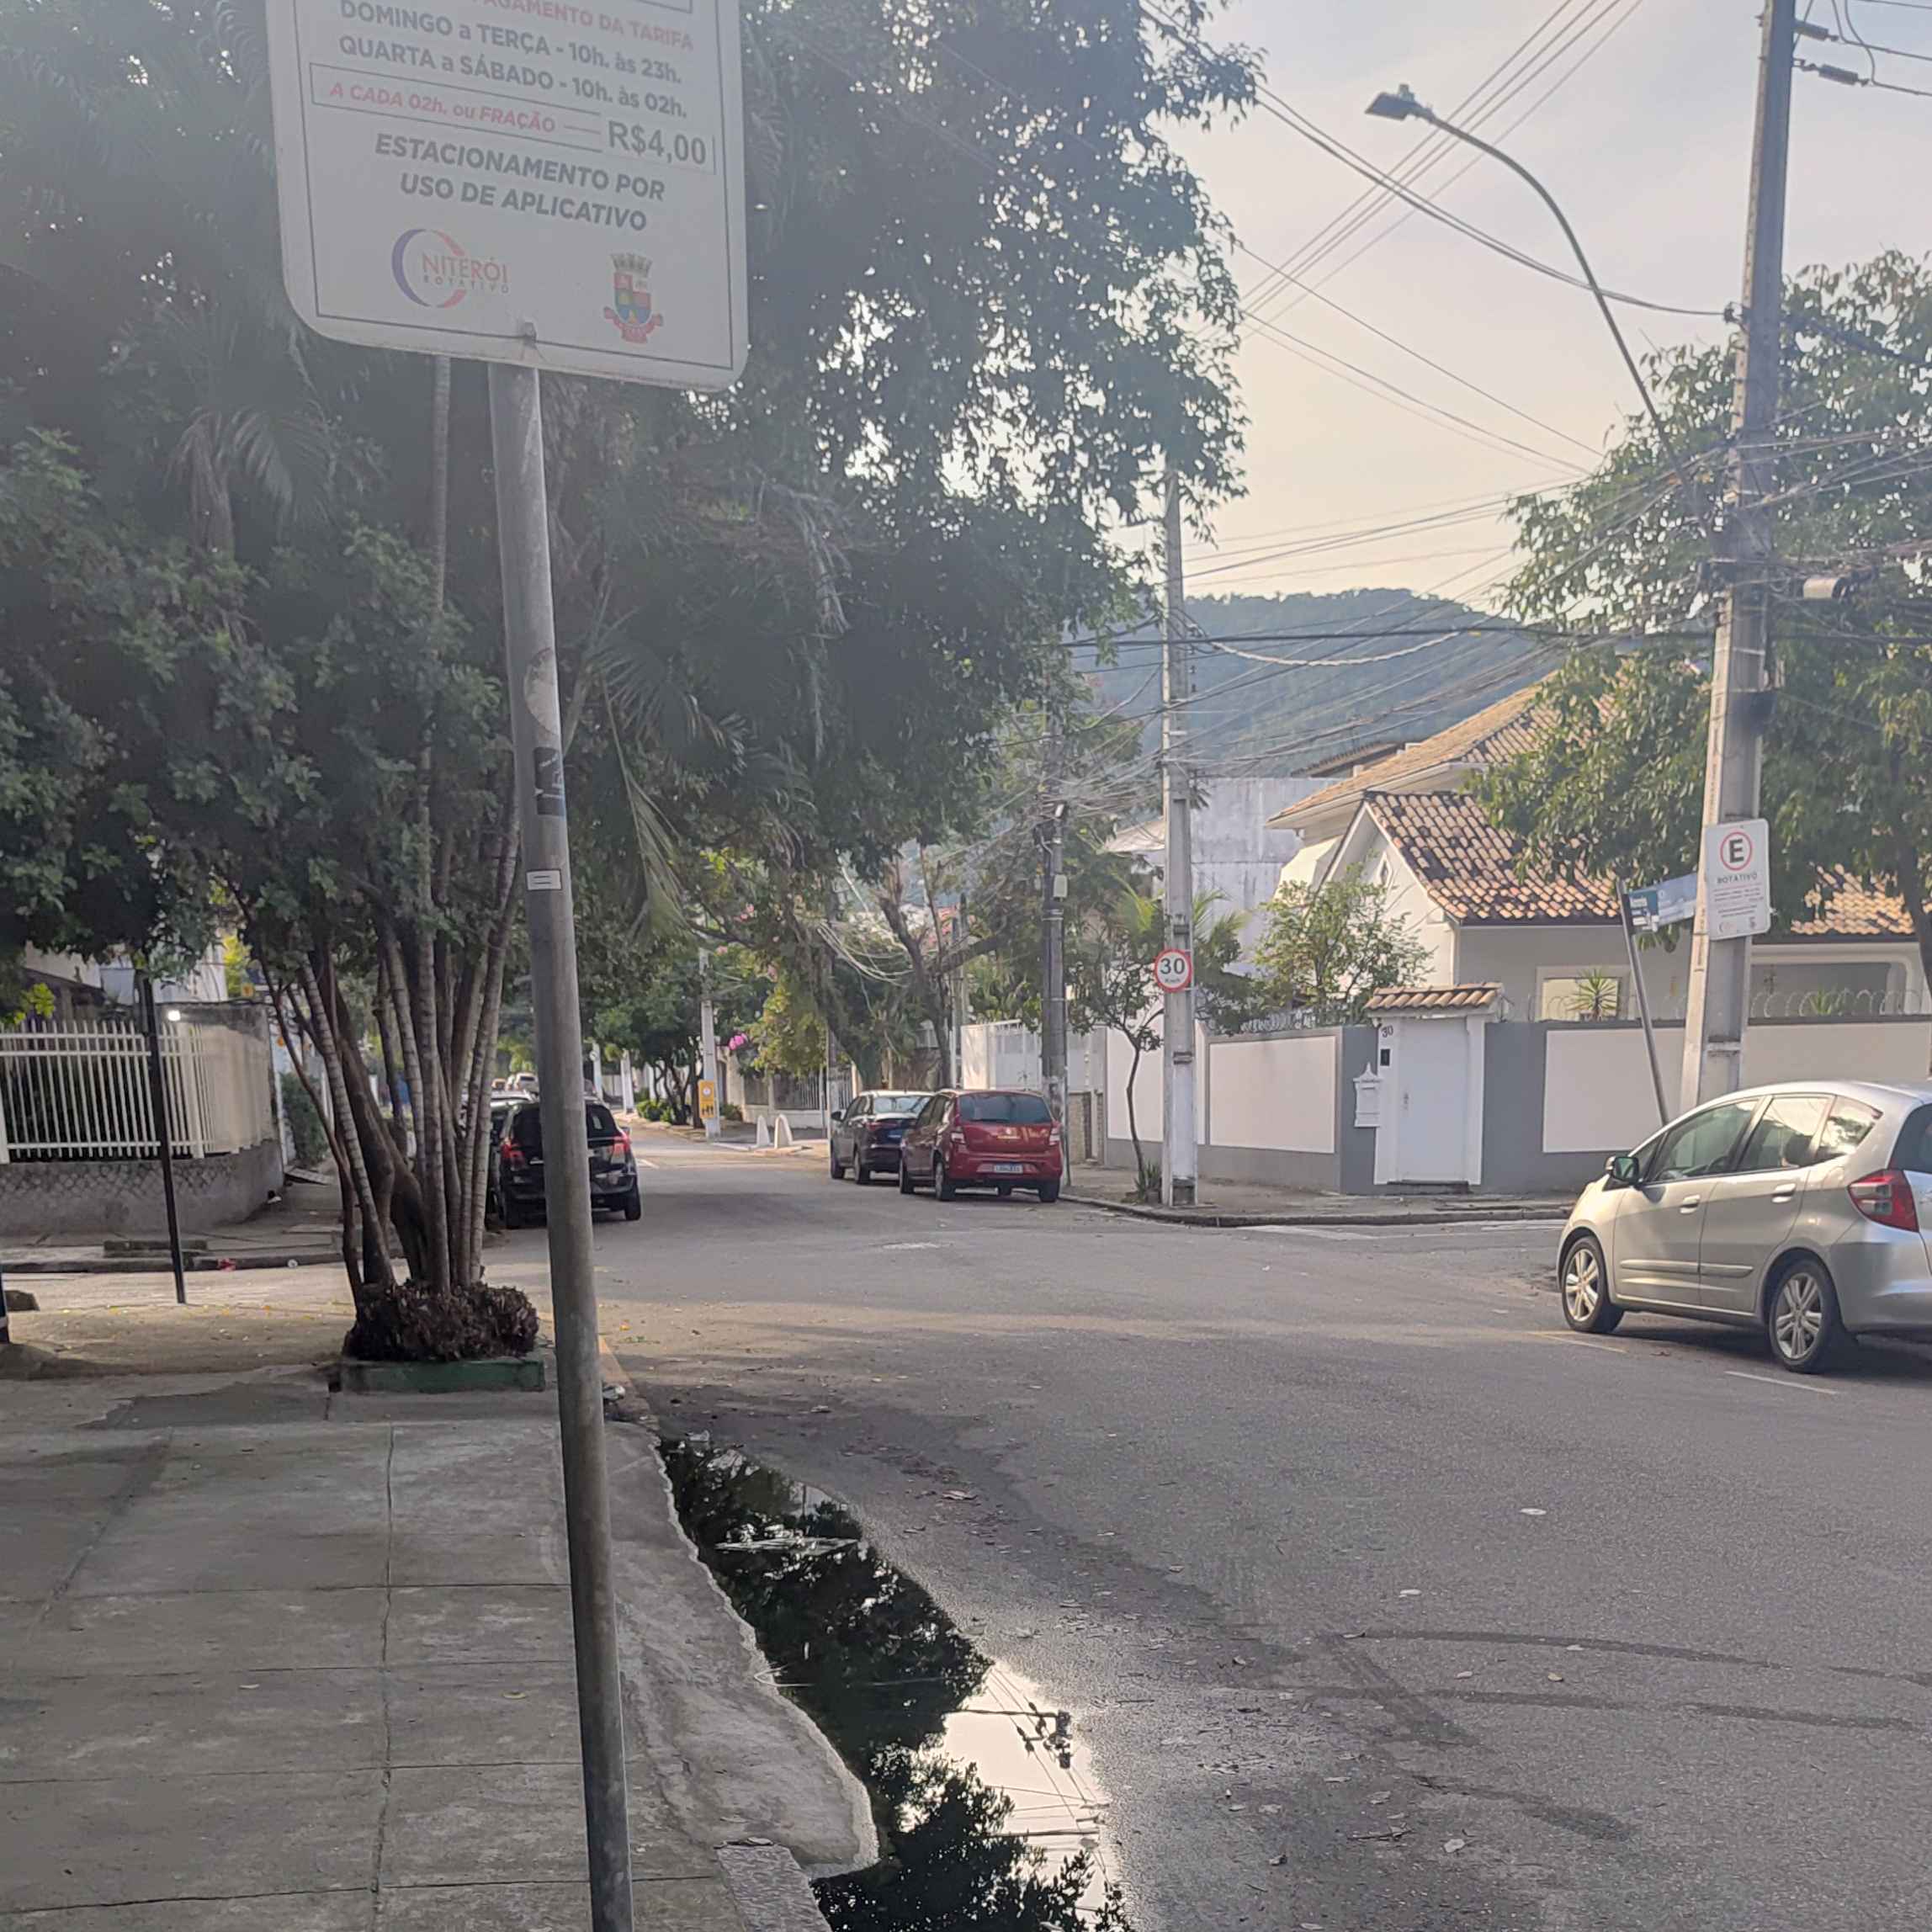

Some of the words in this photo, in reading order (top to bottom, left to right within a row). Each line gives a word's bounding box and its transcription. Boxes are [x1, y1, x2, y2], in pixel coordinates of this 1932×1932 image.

[340, 0, 453, 36] DOMINGO
[476, 24, 550, 56] TERÇA
[569, 42, 609, 68] 10h.
[614, 51, 637, 74] às
[641, 58, 682, 83] 23h.
[598, 13, 624, 35] DA
[627, 20, 694, 52] TARIFA
[339, 35, 437, 69] QUARTA
[459, 53, 554, 90] SÁBADO
[572, 77, 613, 103] 10h.
[618, 86, 640, 109] às
[645, 93, 687, 119] 02h.
[329, 82, 343, 98] A
[350, 85, 403, 108] CADA
[409, 93, 448, 114] 02h.
[453, 104, 475, 119] ou
[478, 105, 555, 133] FRAÇÃO
[608, 120, 707, 165] R$4,00
[375, 133, 609, 191] ESTACIONAMENTO
[615, 173, 665, 201] POR
[400, 172, 454, 199] USO
[461, 182, 496, 206] DE
[501, 188, 647, 231] APLICATIVO
[422, 252, 507, 284] NITERÓI
[1728, 838, 1744, 863] E
[1160, 958, 1186, 974] 30
